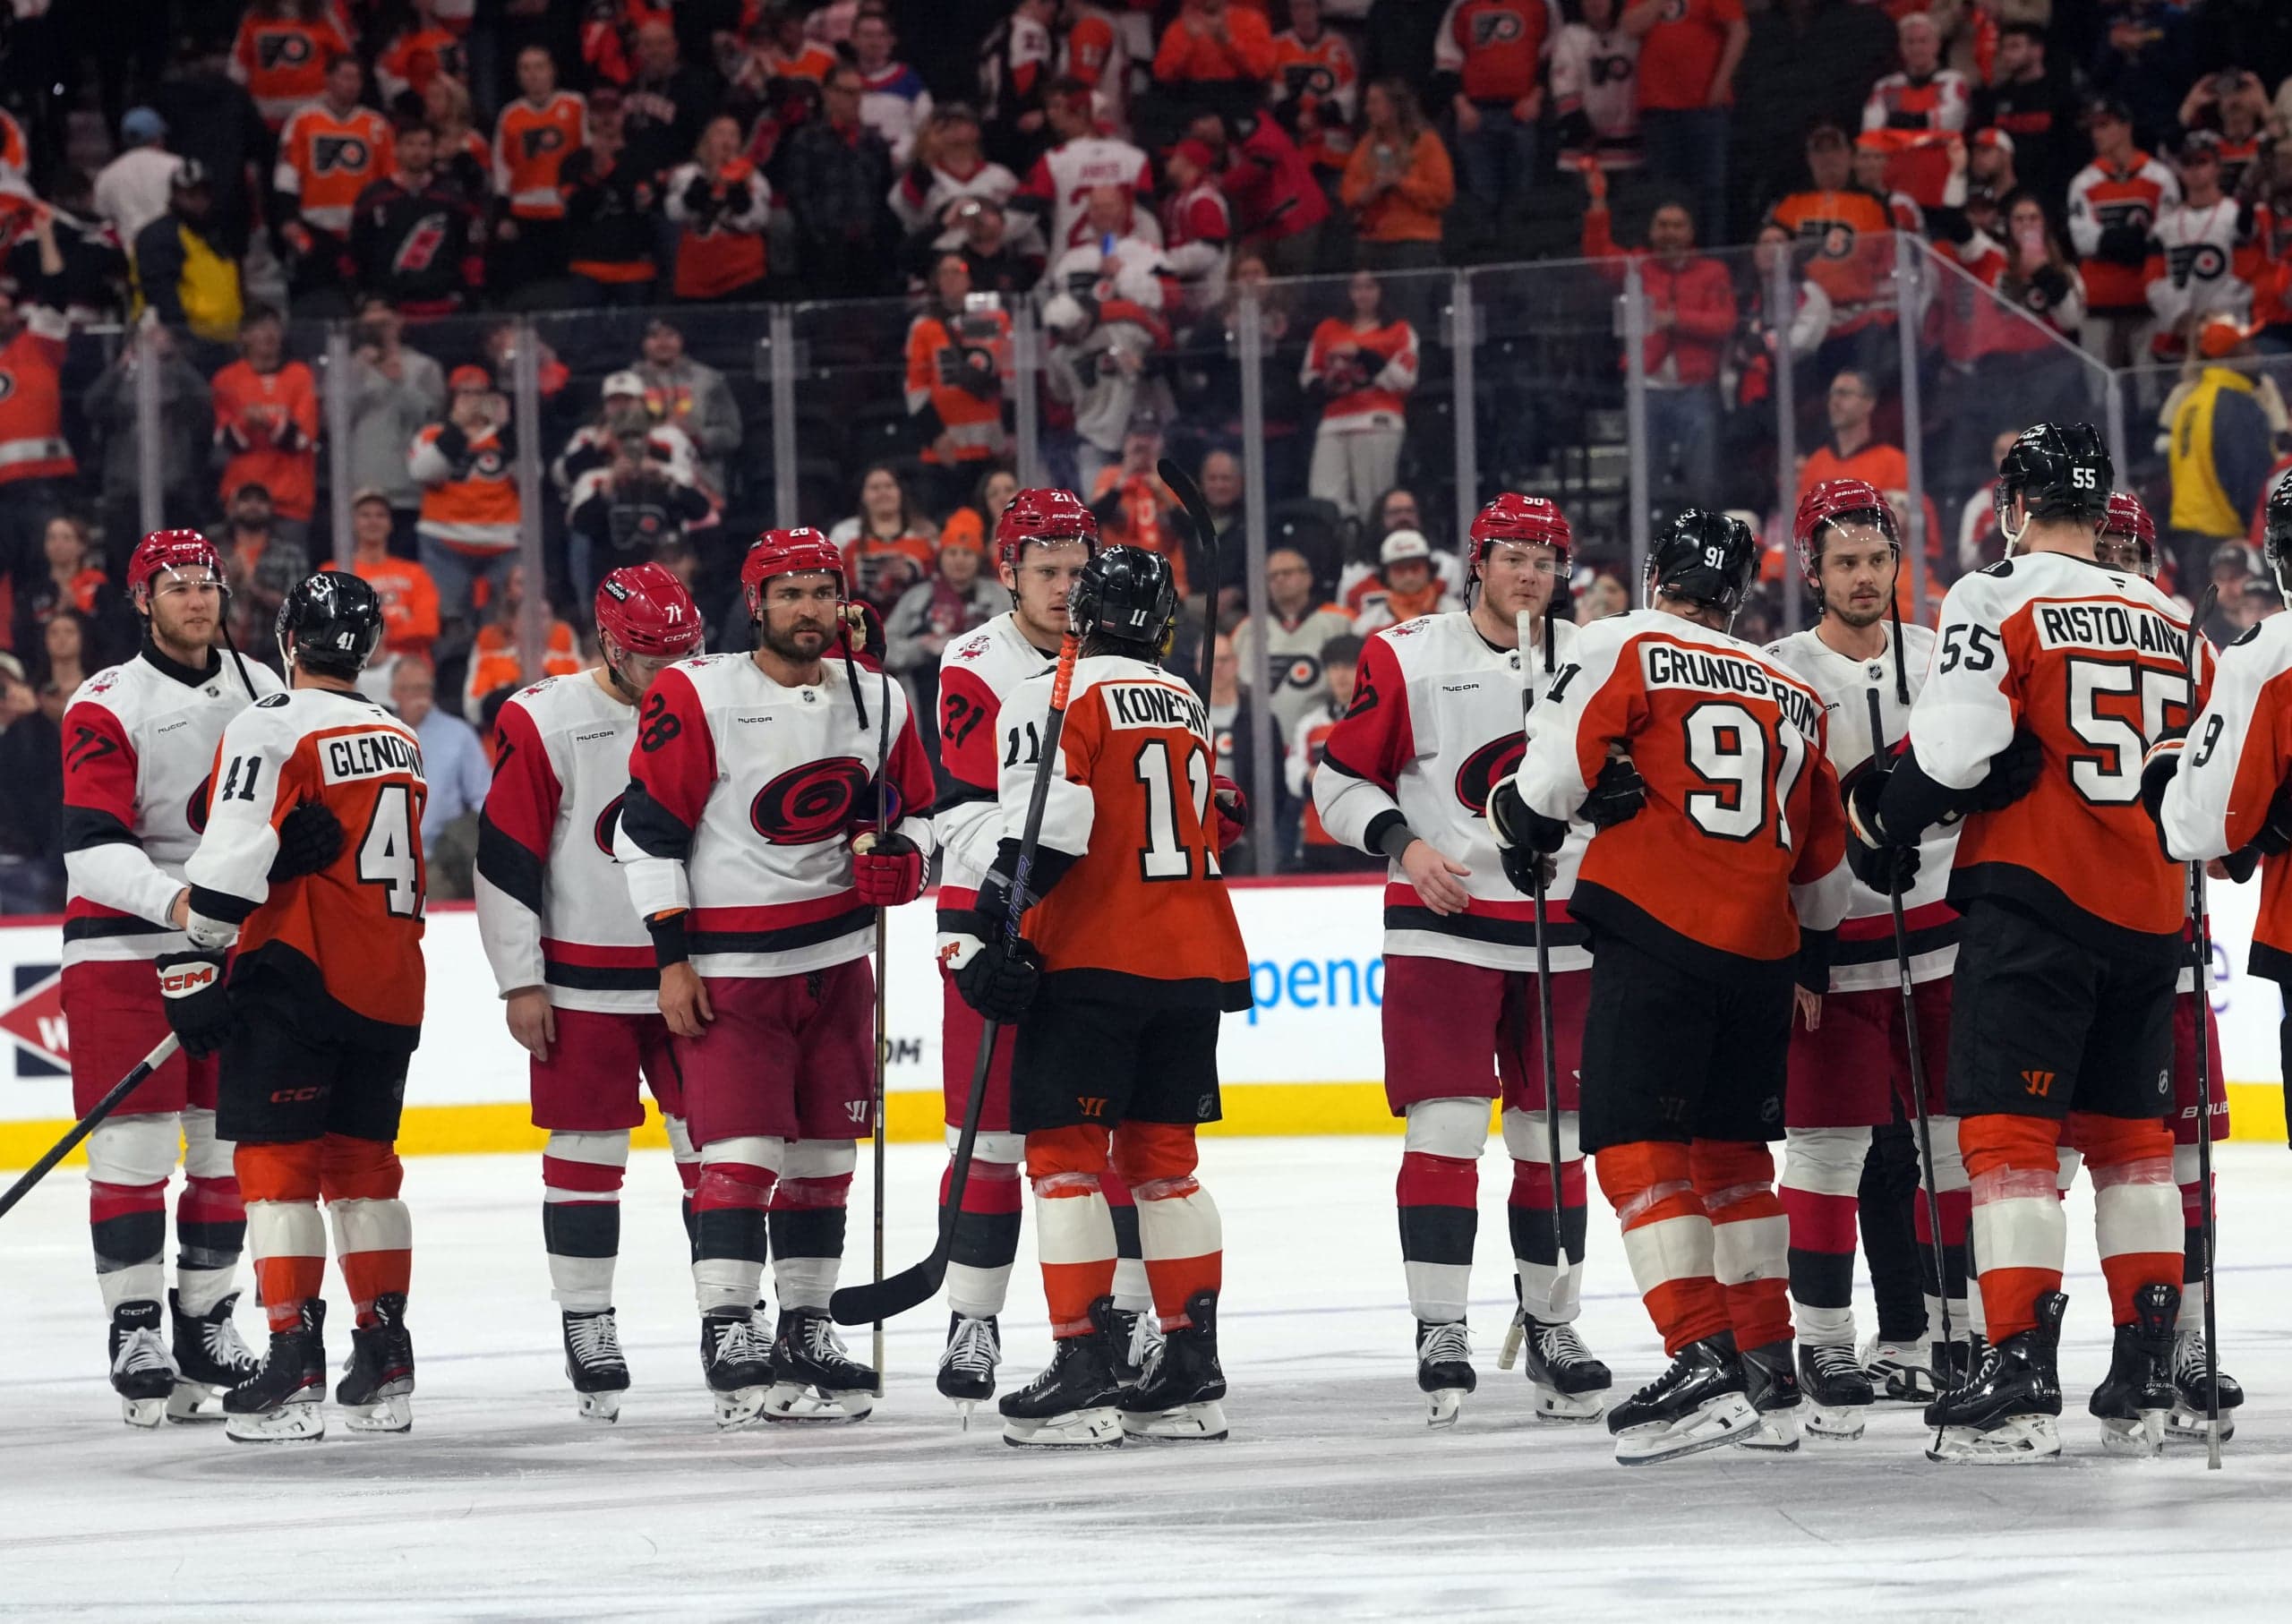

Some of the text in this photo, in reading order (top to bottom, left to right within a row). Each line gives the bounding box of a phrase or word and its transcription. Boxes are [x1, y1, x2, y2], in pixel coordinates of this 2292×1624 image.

[2073, 467, 2096, 490] 55
[1834, 489, 1866, 498] BAUER
[171, 543, 203, 551] CCM
[1705, 546, 1725, 570] 91
[605, 579, 626, 601] Lenovo
[664, 604, 683, 624] 71
[1129, 609, 1149, 627] 11
[337, 632, 355, 651] 41
[663, 632, 691, 643] CCM
[1939, 624, 2001, 675] 55
[1442, 683, 1479, 692] NUCOR
[158, 721, 188, 734] NUCOR
[639, 692, 681, 754] 28
[943, 694, 985, 749] 21
[576, 730, 615, 742] NUCOR
[1004, 722, 1040, 769] 11
[2192, 714, 2225, 767] 9
[65, 726, 118, 774] 77
[222, 756, 262, 802] 41
[1682, 699, 1808, 853] 91
[159, 967, 213, 992] CM
[120, 1306, 154, 1317] CCM
